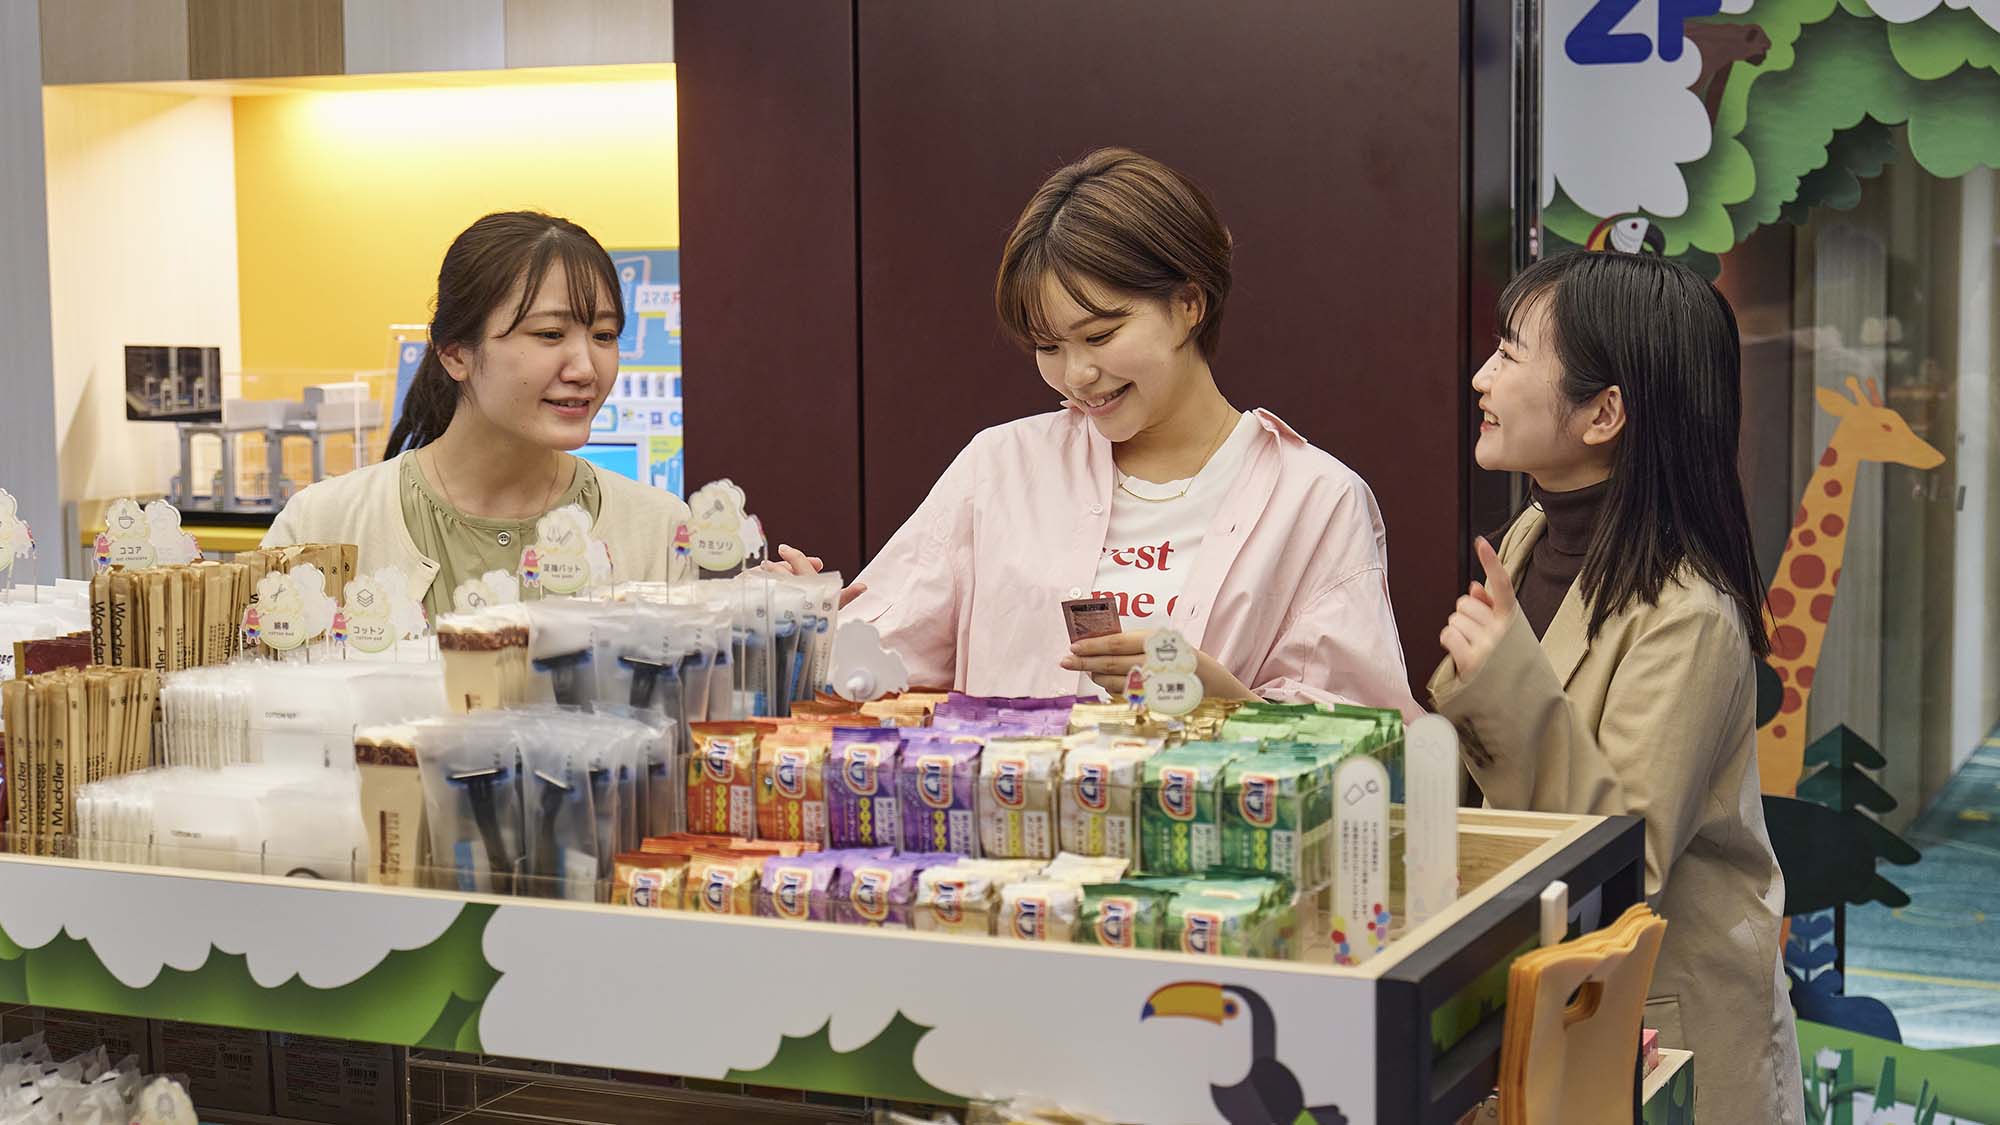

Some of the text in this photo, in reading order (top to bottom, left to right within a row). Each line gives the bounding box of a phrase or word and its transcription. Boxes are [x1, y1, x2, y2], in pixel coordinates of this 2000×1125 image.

[119, 546, 142, 555] ココア
[698, 539, 734, 551] カミソリ
[1102, 540, 1175, 571] est
[112, 602, 126, 666] Wooden
[353, 625, 385, 635] コットン
[1156, 683, 1185, 694] 入浴剤
[52, 760, 65, 826] Muddler
